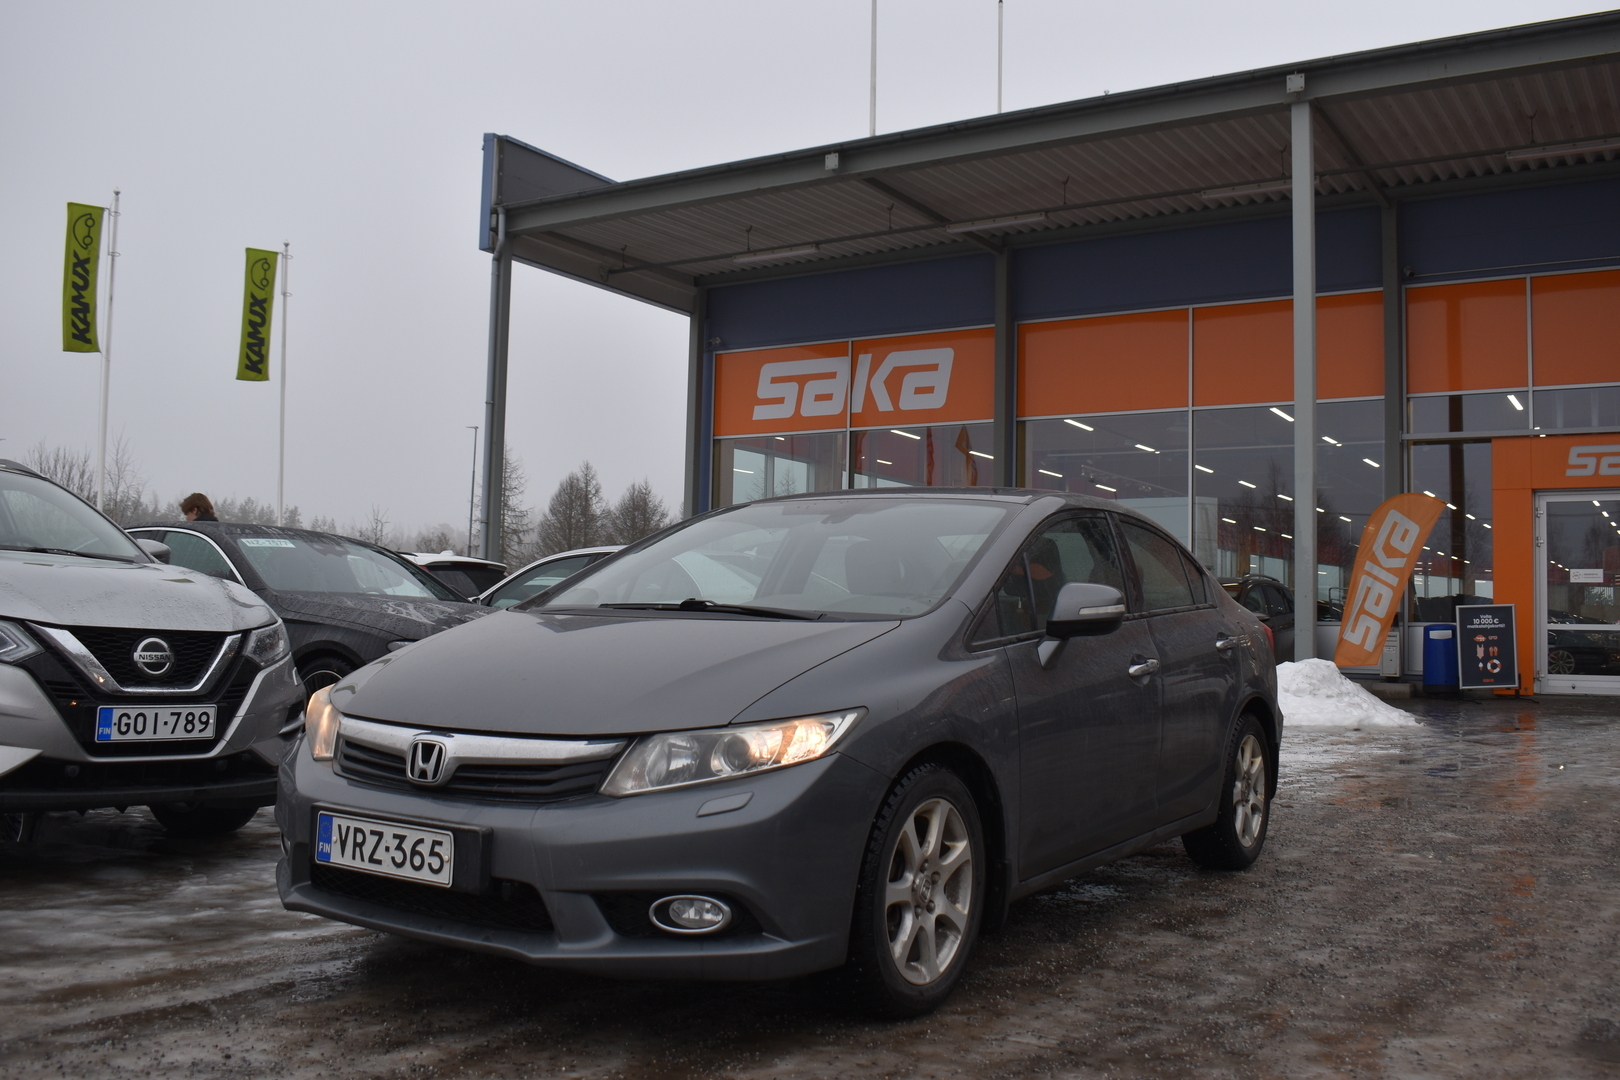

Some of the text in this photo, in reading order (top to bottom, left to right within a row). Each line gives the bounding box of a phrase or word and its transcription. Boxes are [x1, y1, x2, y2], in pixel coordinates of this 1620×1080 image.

[71, 249, 92, 345] KAMUX
[244, 292, 268, 375] KAMUX
[138, 653, 171, 661] NISSAN
[98, 711, 211, 736] FIN GOI-789
[318, 823, 445, 875] FIN VRZ-365
